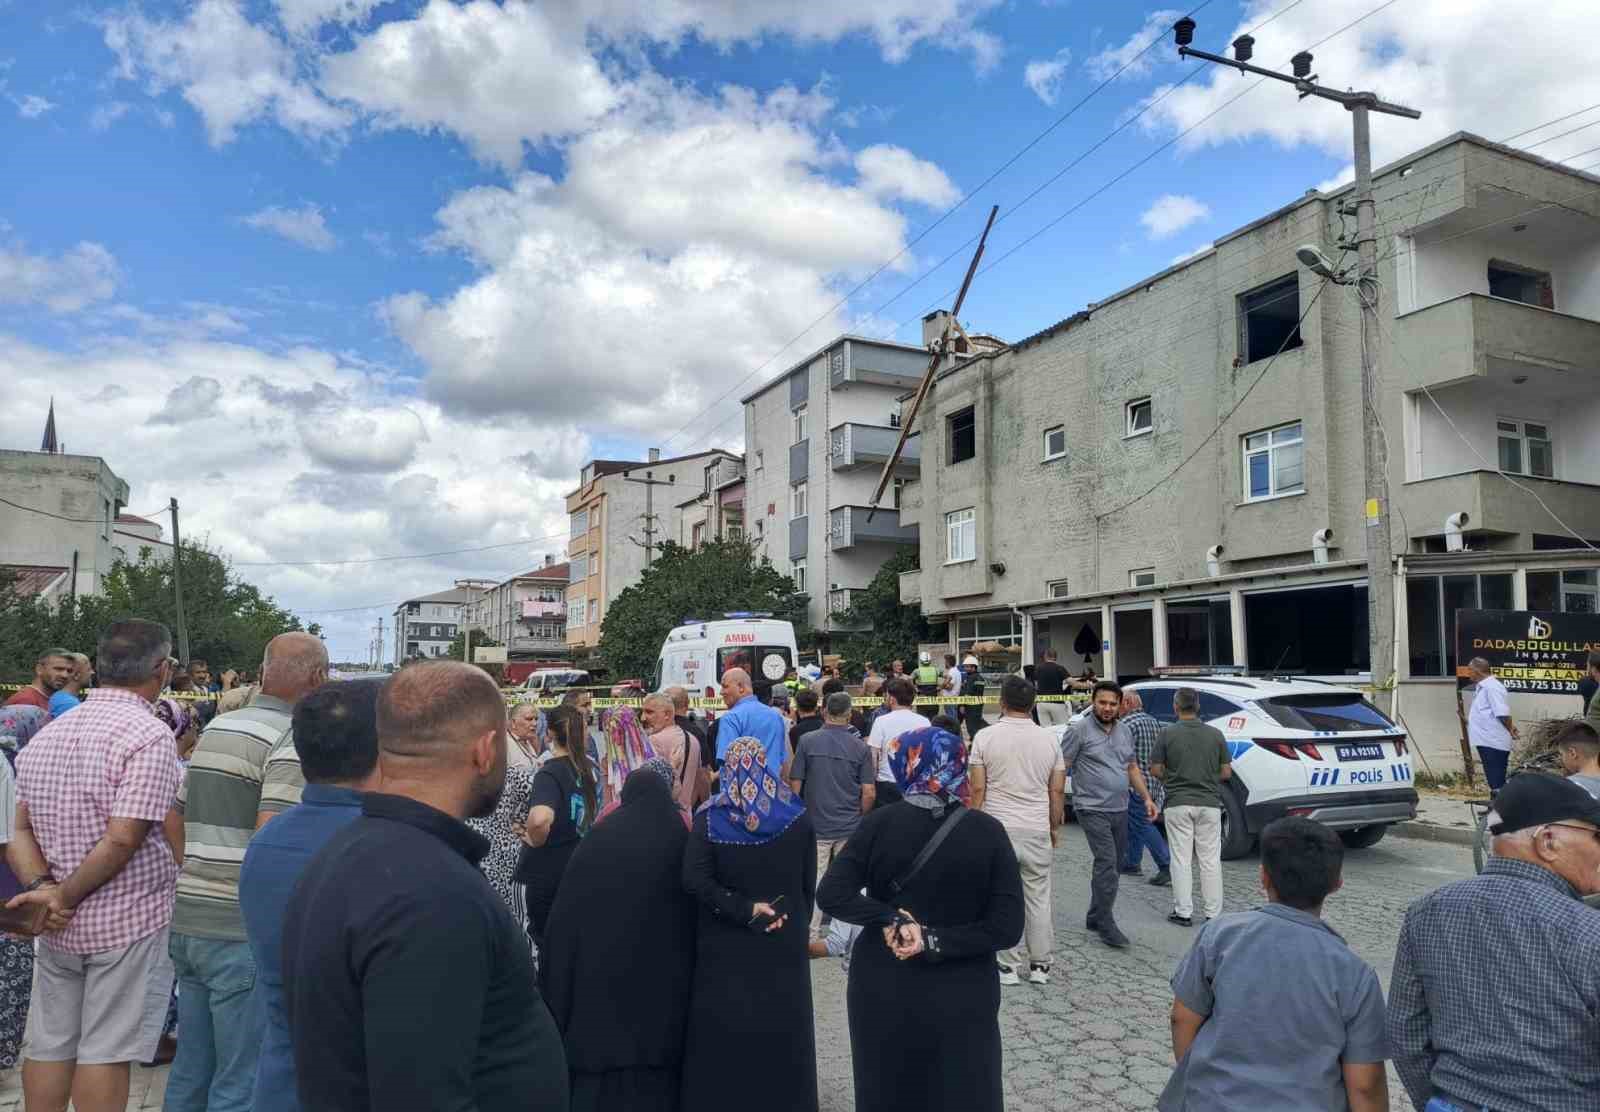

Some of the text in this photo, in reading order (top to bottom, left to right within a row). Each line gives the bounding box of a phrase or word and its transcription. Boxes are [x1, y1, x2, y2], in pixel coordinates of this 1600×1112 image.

[724, 633, 755, 643] AMBU
[1488, 668, 1535, 679] ROJE
[1503, 679, 1578, 691] 0531 725 13 20
[1350, 767, 1383, 784] POLİS
